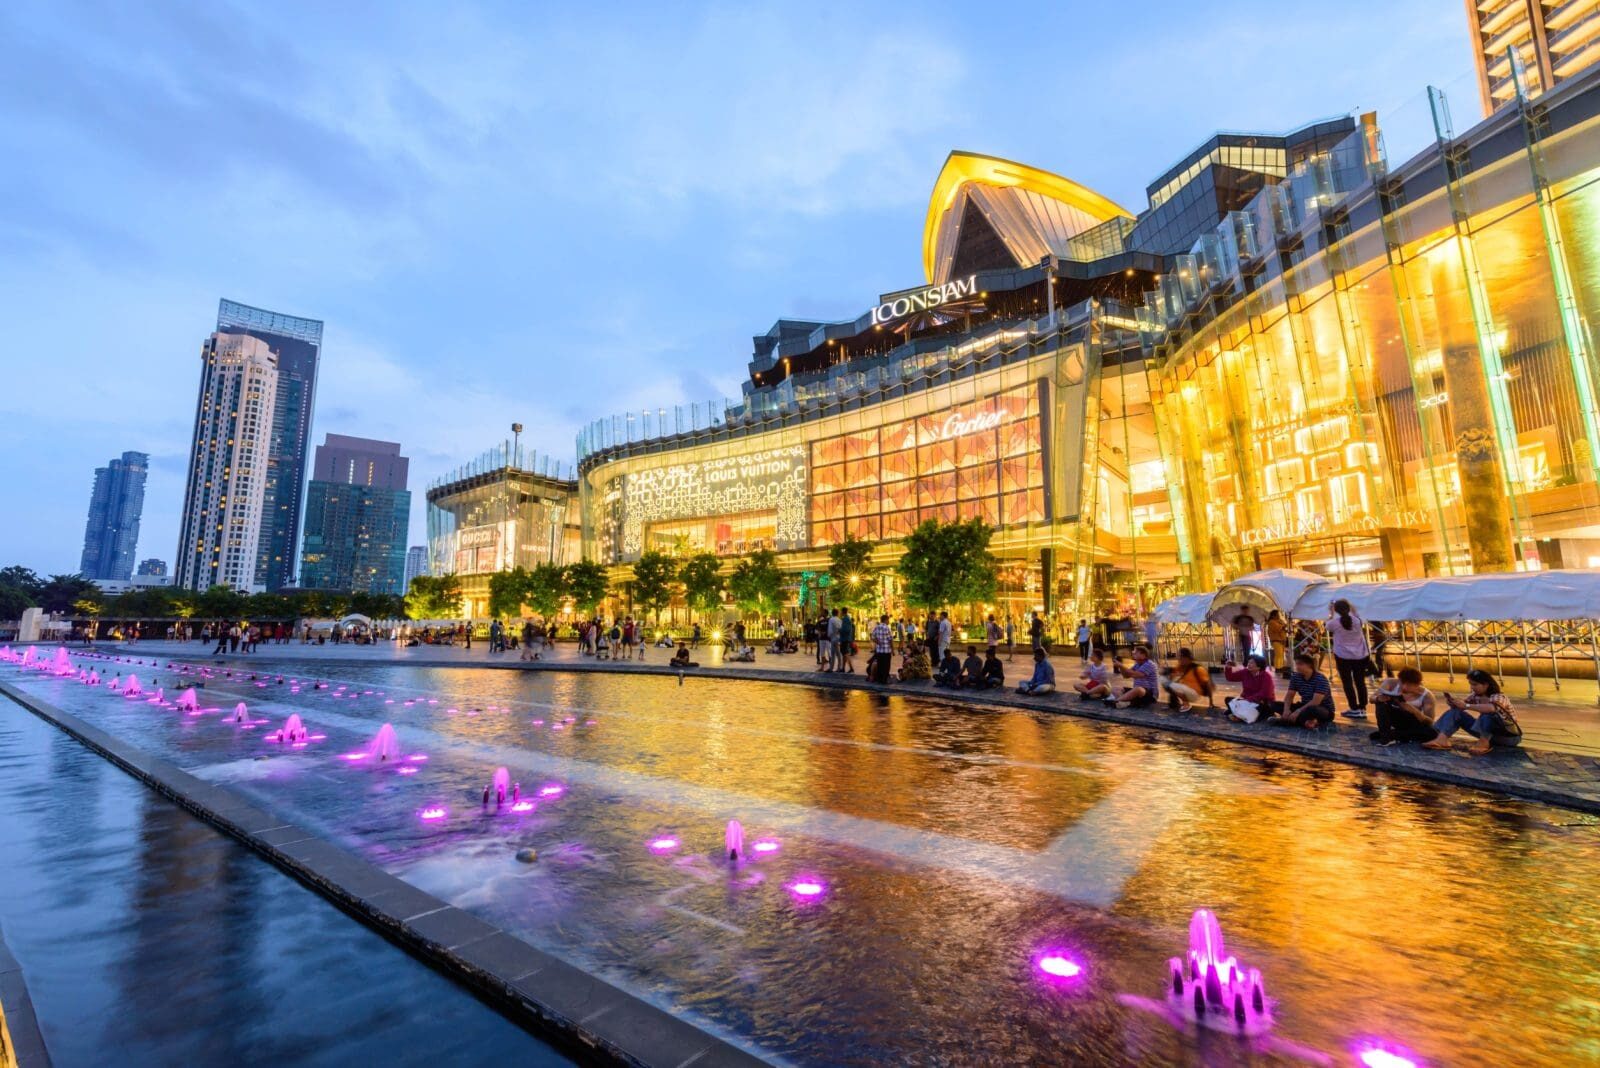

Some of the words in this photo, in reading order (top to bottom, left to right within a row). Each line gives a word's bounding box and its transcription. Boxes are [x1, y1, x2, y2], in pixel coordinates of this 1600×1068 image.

[871, 275, 977, 325] ICONSIAM
[942, 409, 1008, 439] Cartier
[706, 468, 737, 483] LOUIS
[741, 460, 790, 478] VUITTON
[462, 530, 491, 545] GUCCI
